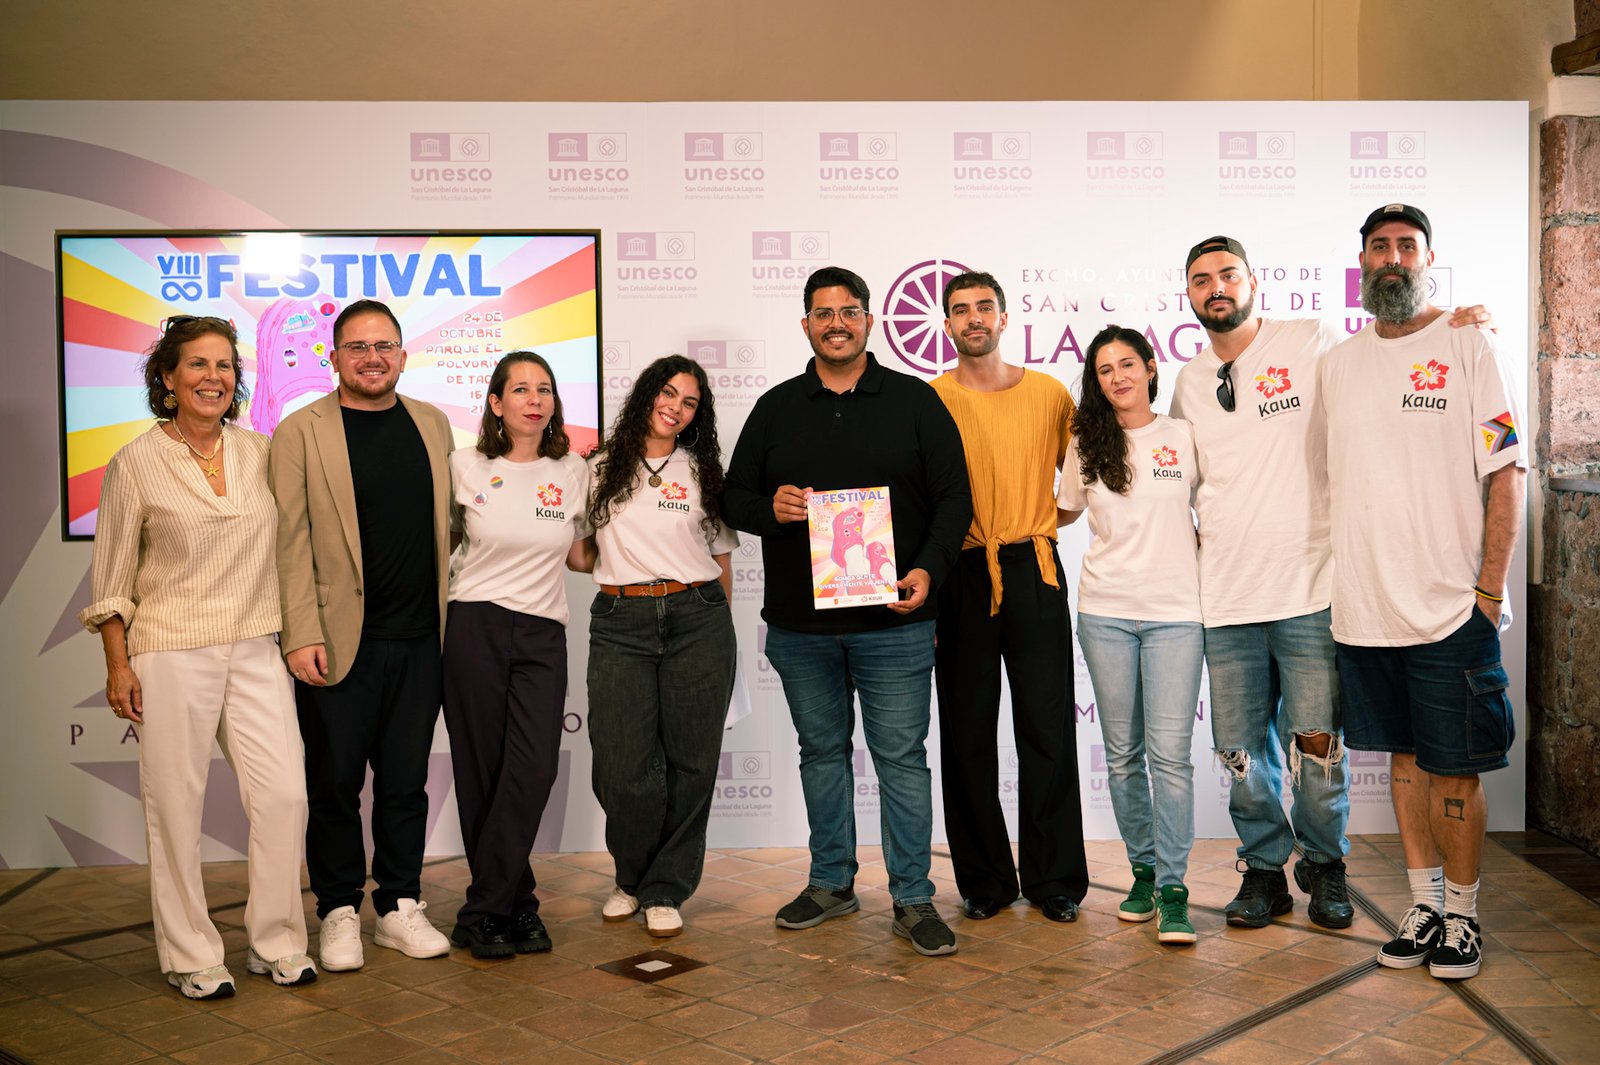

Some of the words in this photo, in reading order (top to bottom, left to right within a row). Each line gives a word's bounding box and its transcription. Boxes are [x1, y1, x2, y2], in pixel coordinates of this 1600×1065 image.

[410, 167, 492, 181] unesco
[548, 167, 629, 181] unesco
[684, 167, 764, 181] unesco
[819, 167, 899, 180] unesco
[953, 166, 1032, 180] unesco
[1087, 166, 1165, 179] unesco
[1218, 166, 1296, 179] unesco
[1349, 165, 1427, 179] unesco
[157, 255, 200, 275] VIII
[206, 253, 501, 299] FESTIVAL
[617, 266, 697, 280] unesco
[752, 266, 817, 280] unes
[1300, 268, 1321, 281] DE
[1022, 294, 1079, 312] SAN
[1100, 292, 1270, 312] CRISTL
[1290, 292, 1321, 311] DE
[464, 313, 481, 322] 24
[485, 312, 502, 322] DE
[440, 328, 502, 338] OCTUBRE
[426, 344, 480, 354] PARQUE
[486, 344, 502, 353] EL
[1023, 323, 1086, 363] LA
[447, 376, 464, 384] DE
[469, 376, 492, 384] TAC
[709, 374, 767, 388] nesco
[1258, 396, 1301, 417] Kaua
[1402, 394, 1447, 410] Kaua
[1153, 468, 1182, 478] Kaua
[822, 490, 885, 504] FESTIVAL
[536, 507, 565, 519] Kaua
[658, 500, 690, 512] Kaua
[1351, 772, 1390, 785] une
[714, 785, 773, 799] nesco
